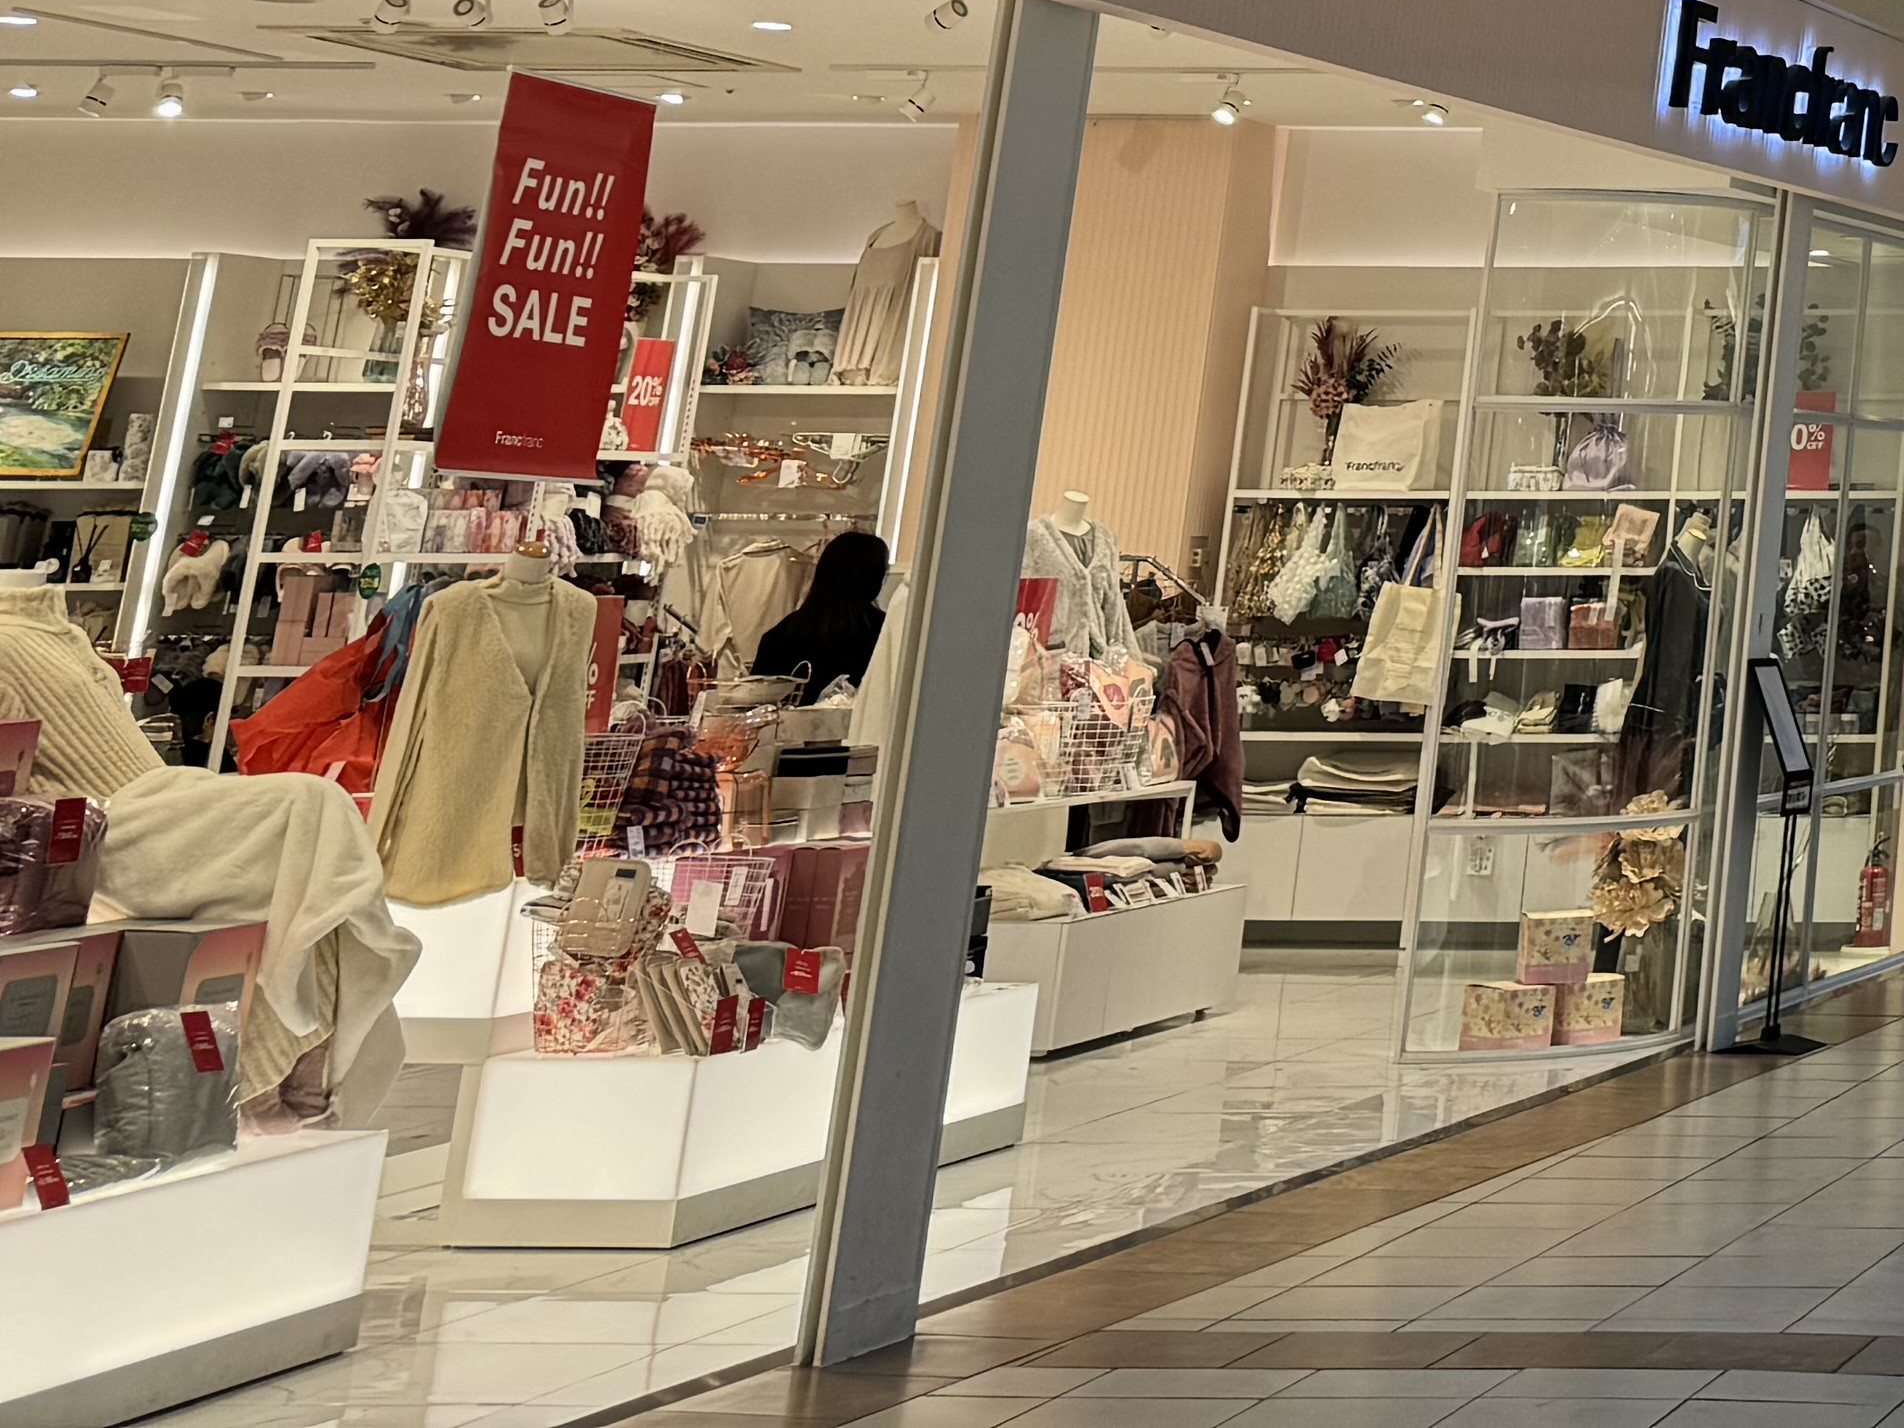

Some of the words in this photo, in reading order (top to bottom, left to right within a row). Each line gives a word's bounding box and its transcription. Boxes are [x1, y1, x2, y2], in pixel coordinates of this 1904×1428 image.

[512, 157, 616, 221] Fun!!
[499, 218, 605, 280] Fun!!
[487, 284, 592, 347] SALE
